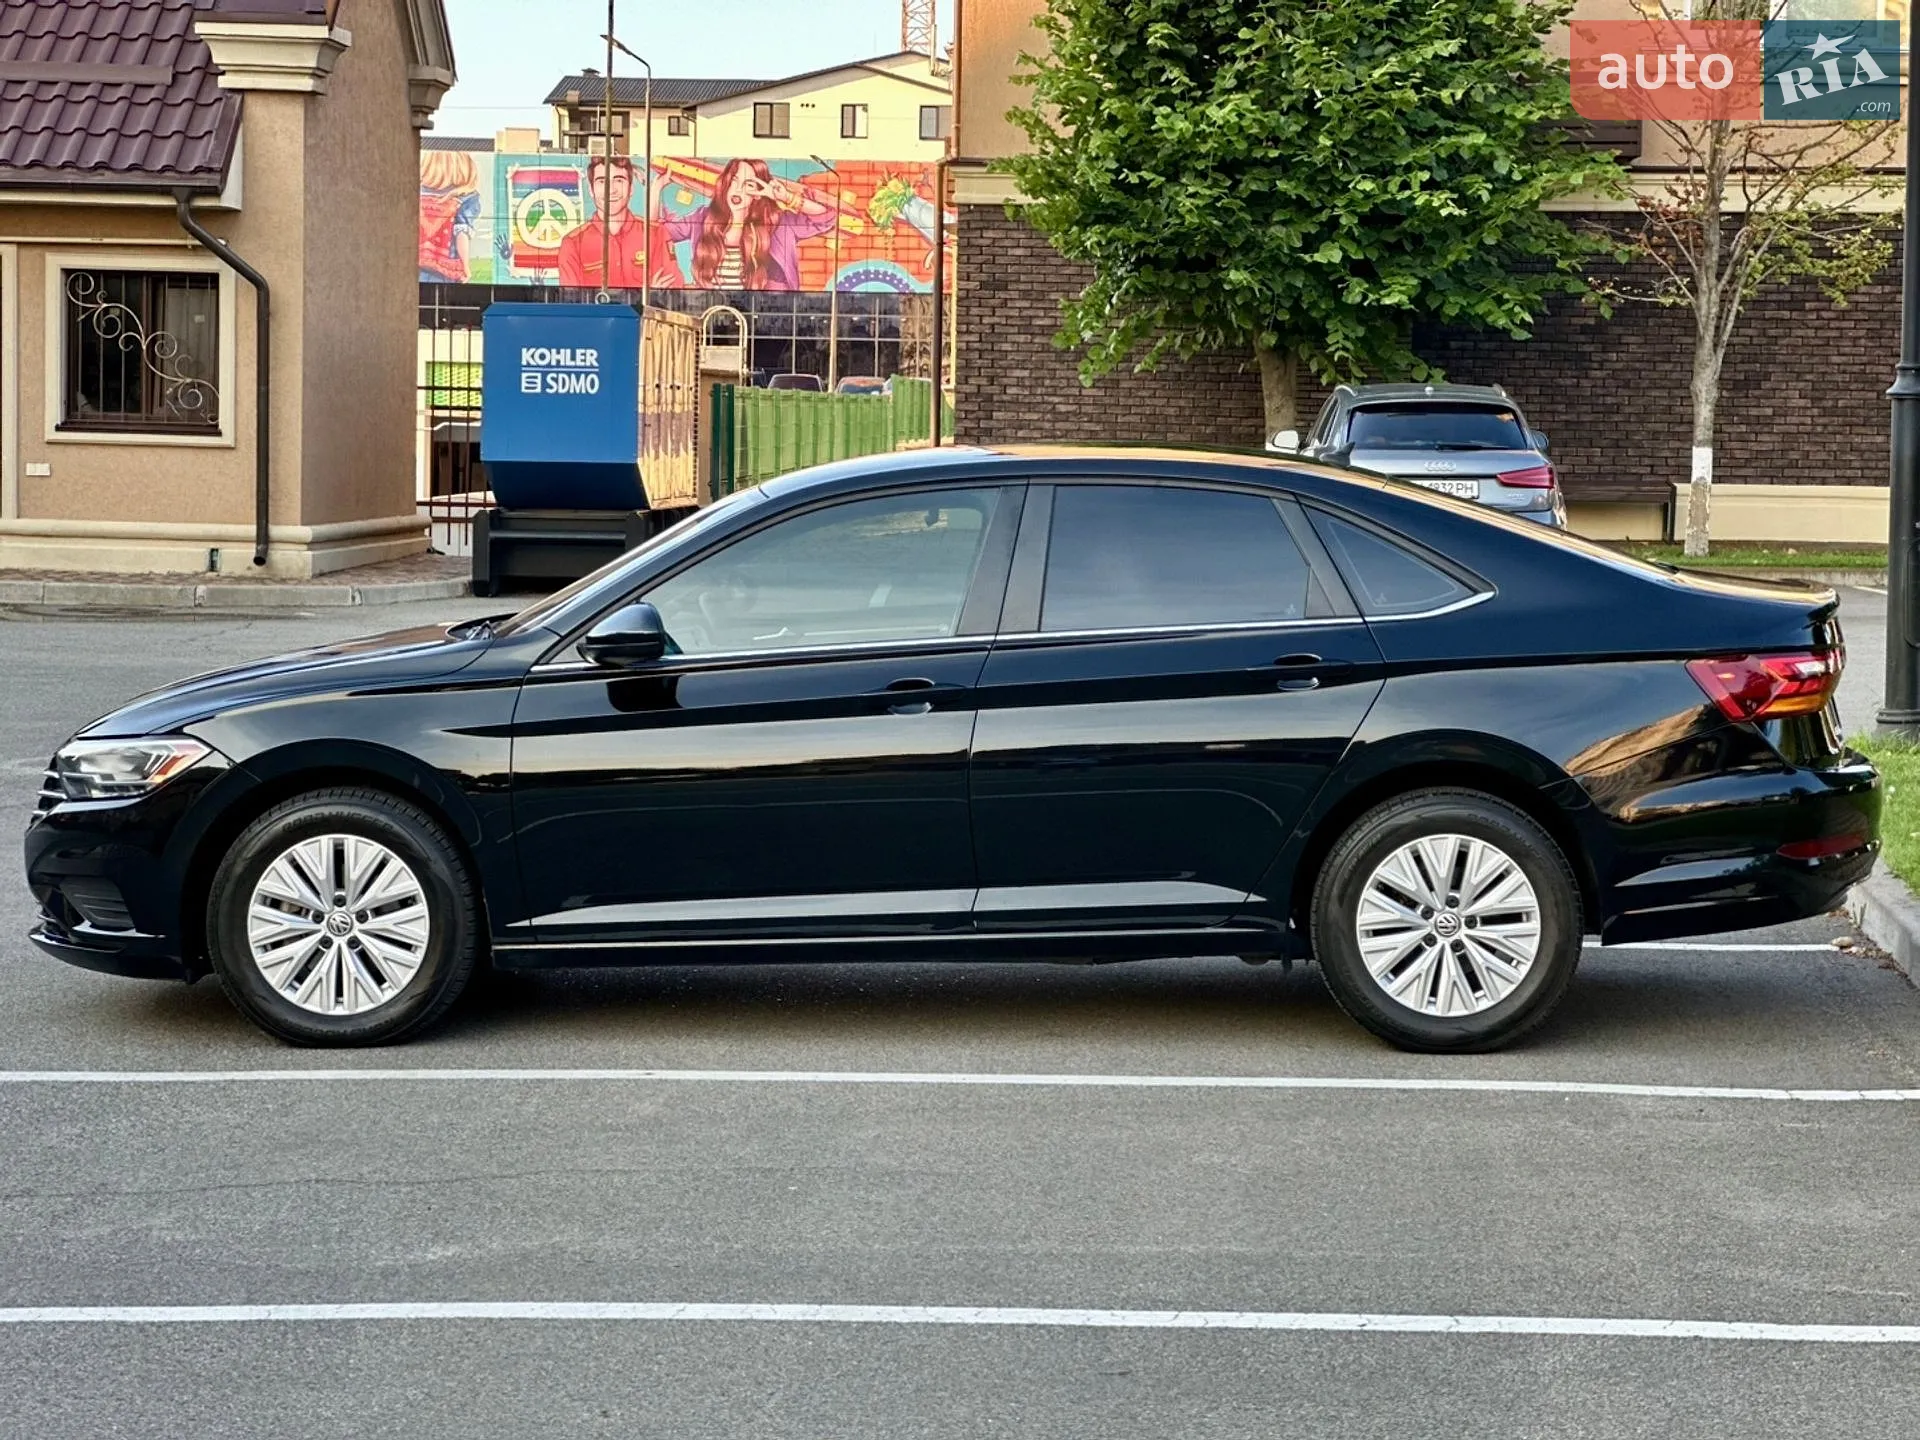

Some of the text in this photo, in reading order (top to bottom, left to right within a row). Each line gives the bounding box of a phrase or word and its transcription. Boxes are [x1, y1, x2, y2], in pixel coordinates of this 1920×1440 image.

[521, 347, 599, 367] KOHLER
[545, 372, 600, 395] SDMO
[1455, 482, 1474, 496] PH
